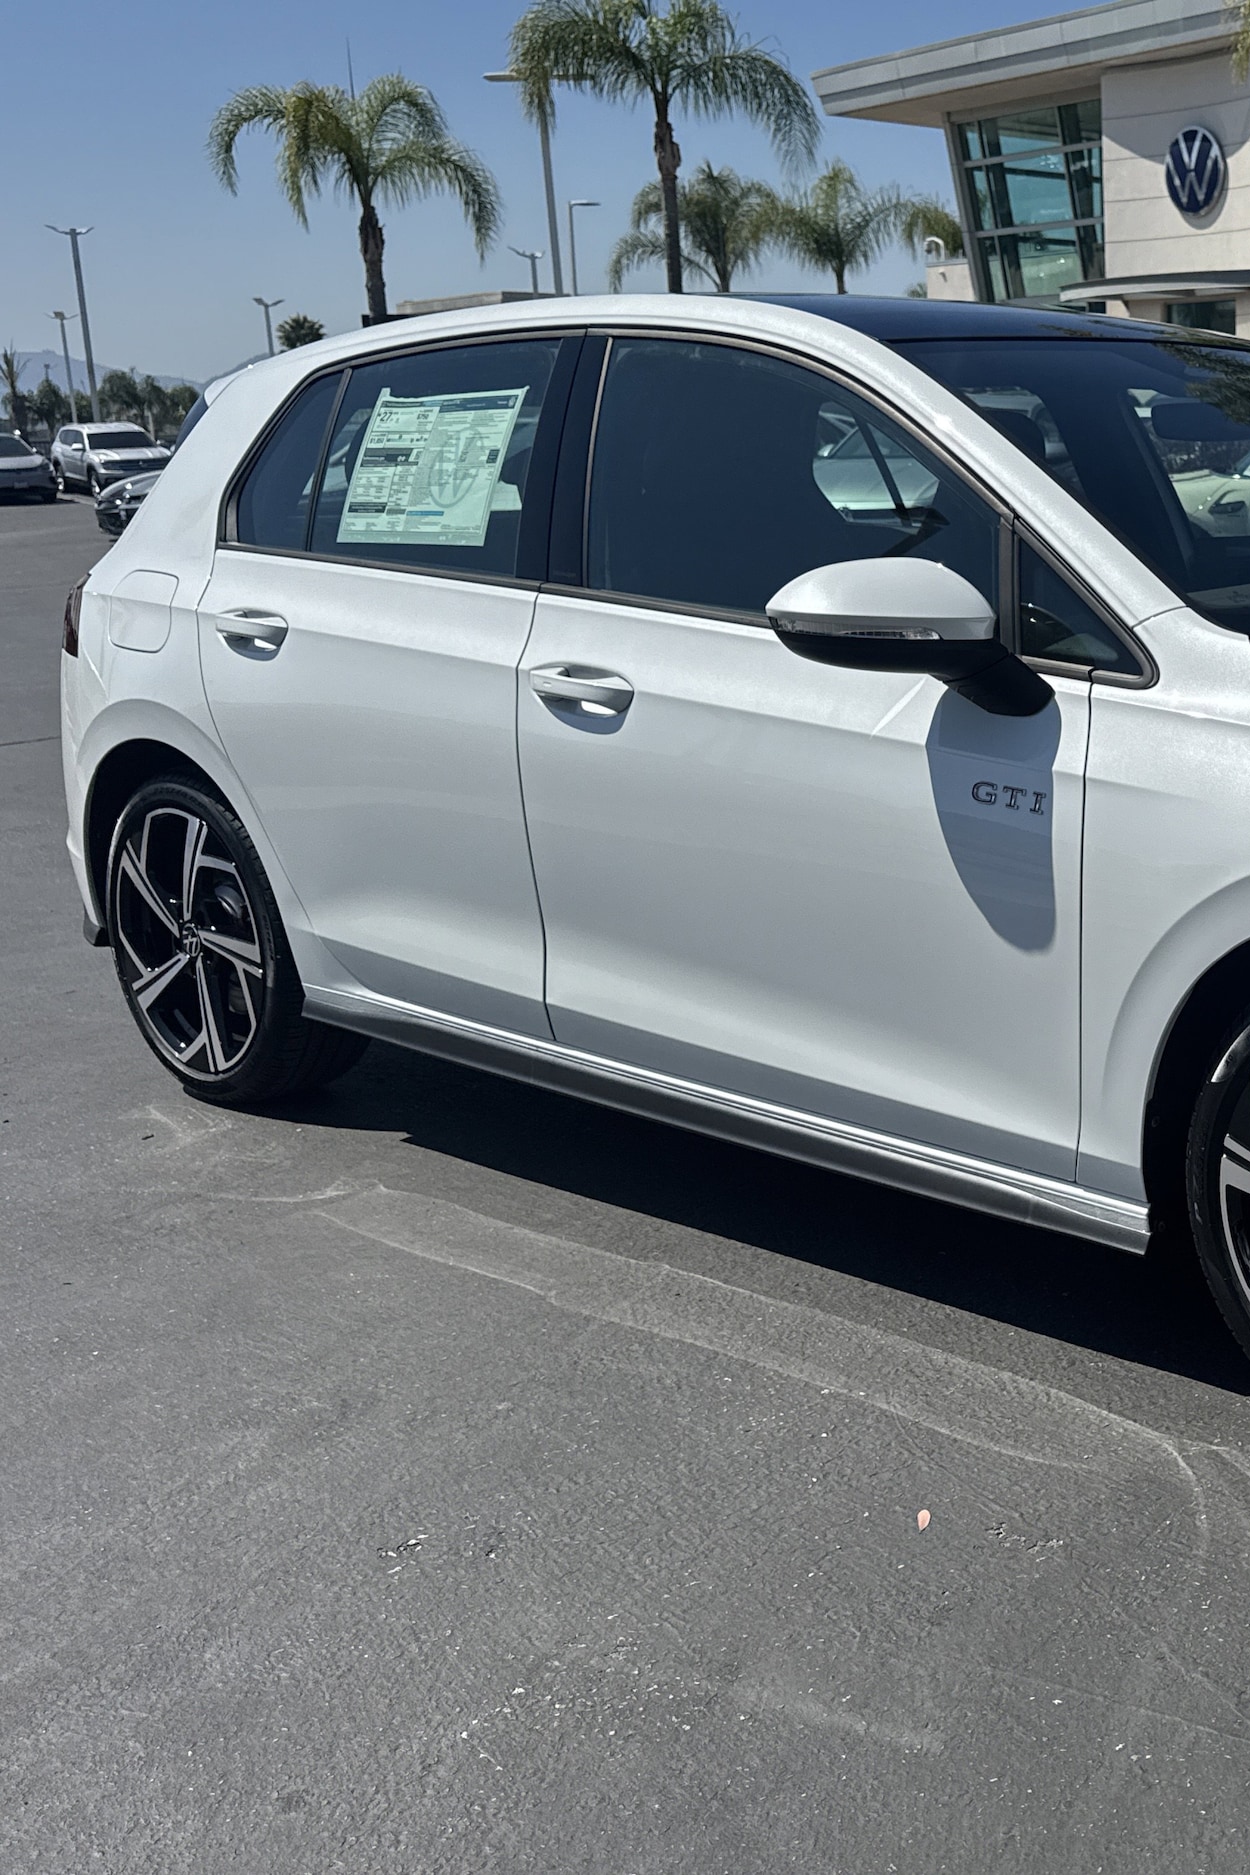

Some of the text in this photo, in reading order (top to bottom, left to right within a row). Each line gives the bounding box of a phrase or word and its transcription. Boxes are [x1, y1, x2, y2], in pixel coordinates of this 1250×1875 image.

[1165, 127, 1223, 213] VW
[379, 411, 393, 422] 27
[971, 781, 1047, 815] GTI
